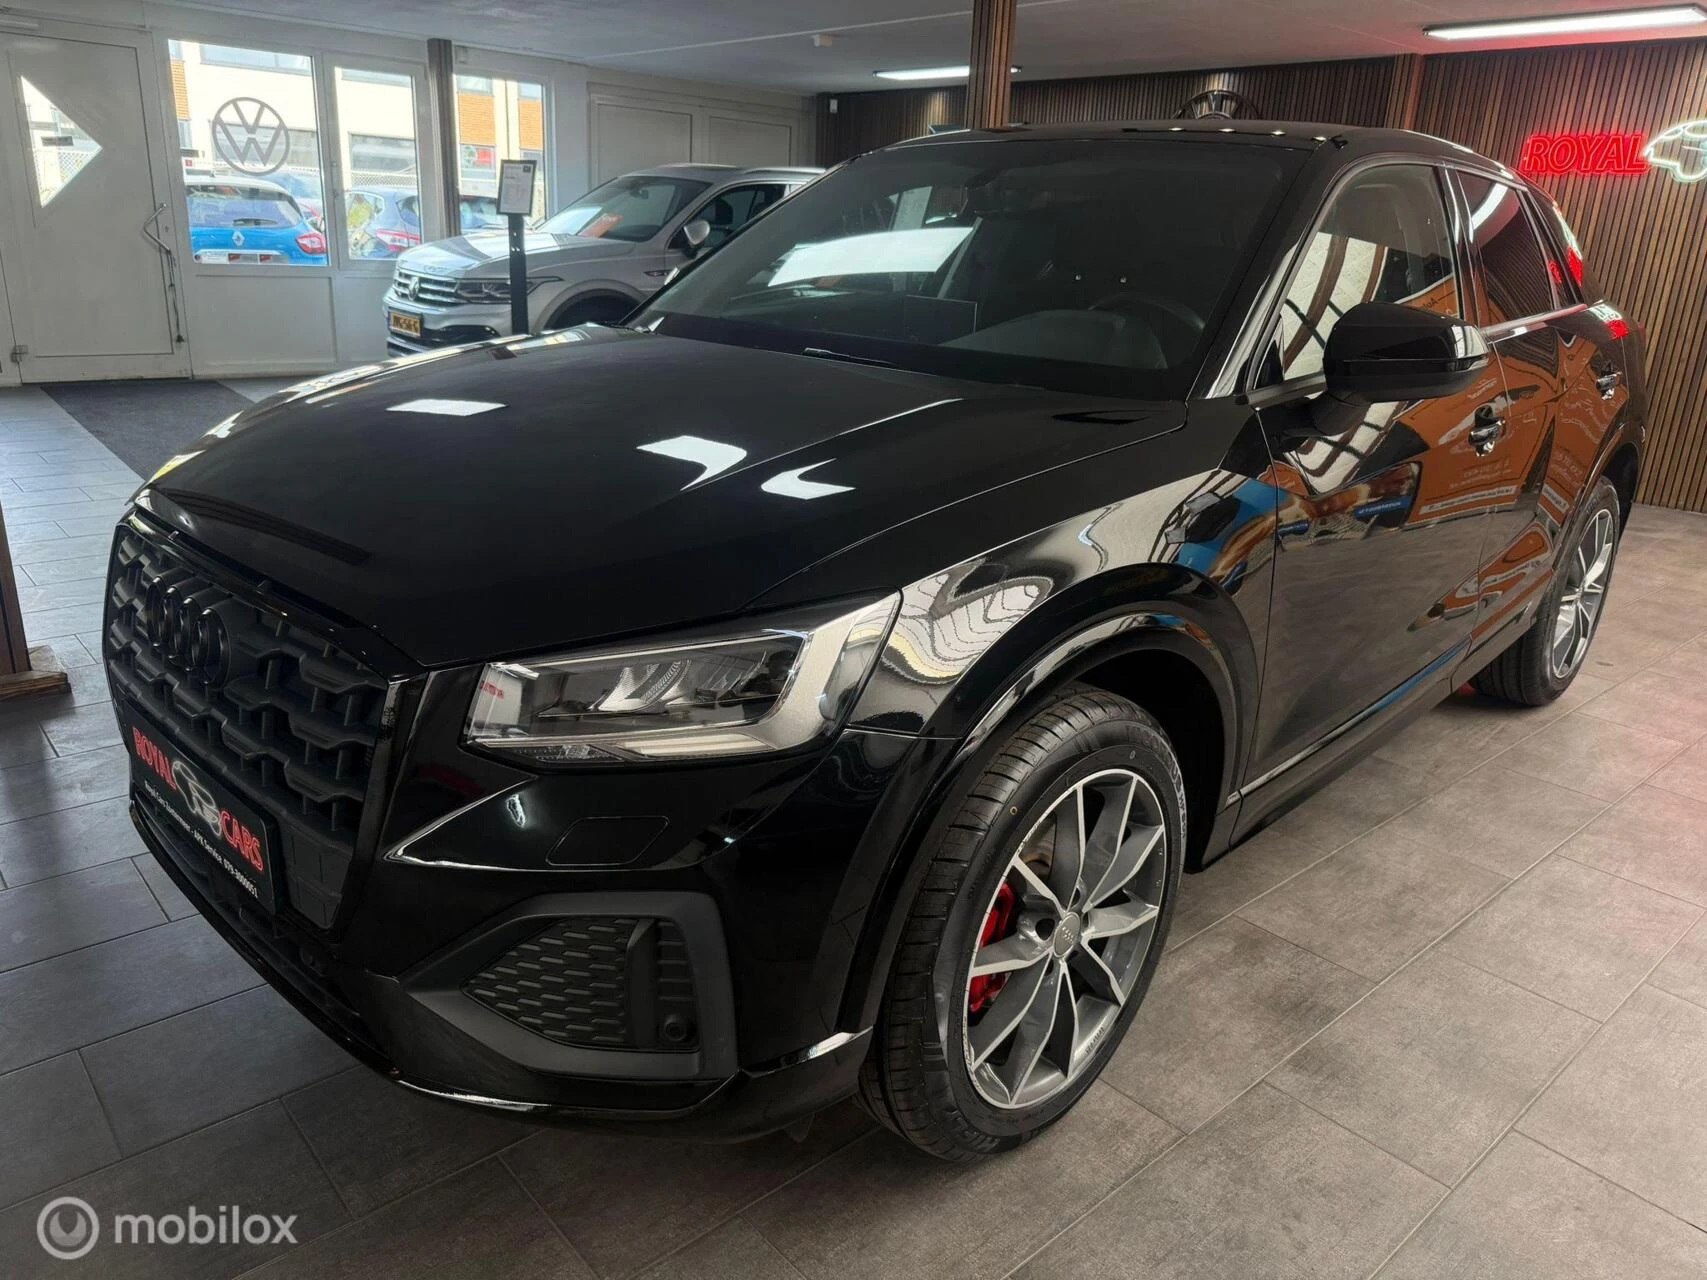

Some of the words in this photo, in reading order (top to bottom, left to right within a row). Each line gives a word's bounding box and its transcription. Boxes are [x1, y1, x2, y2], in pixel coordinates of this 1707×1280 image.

[1522, 134, 1650, 173] ROYAL
[132, 726, 177, 791] ROYAL
[220, 810, 264, 871] CARS
